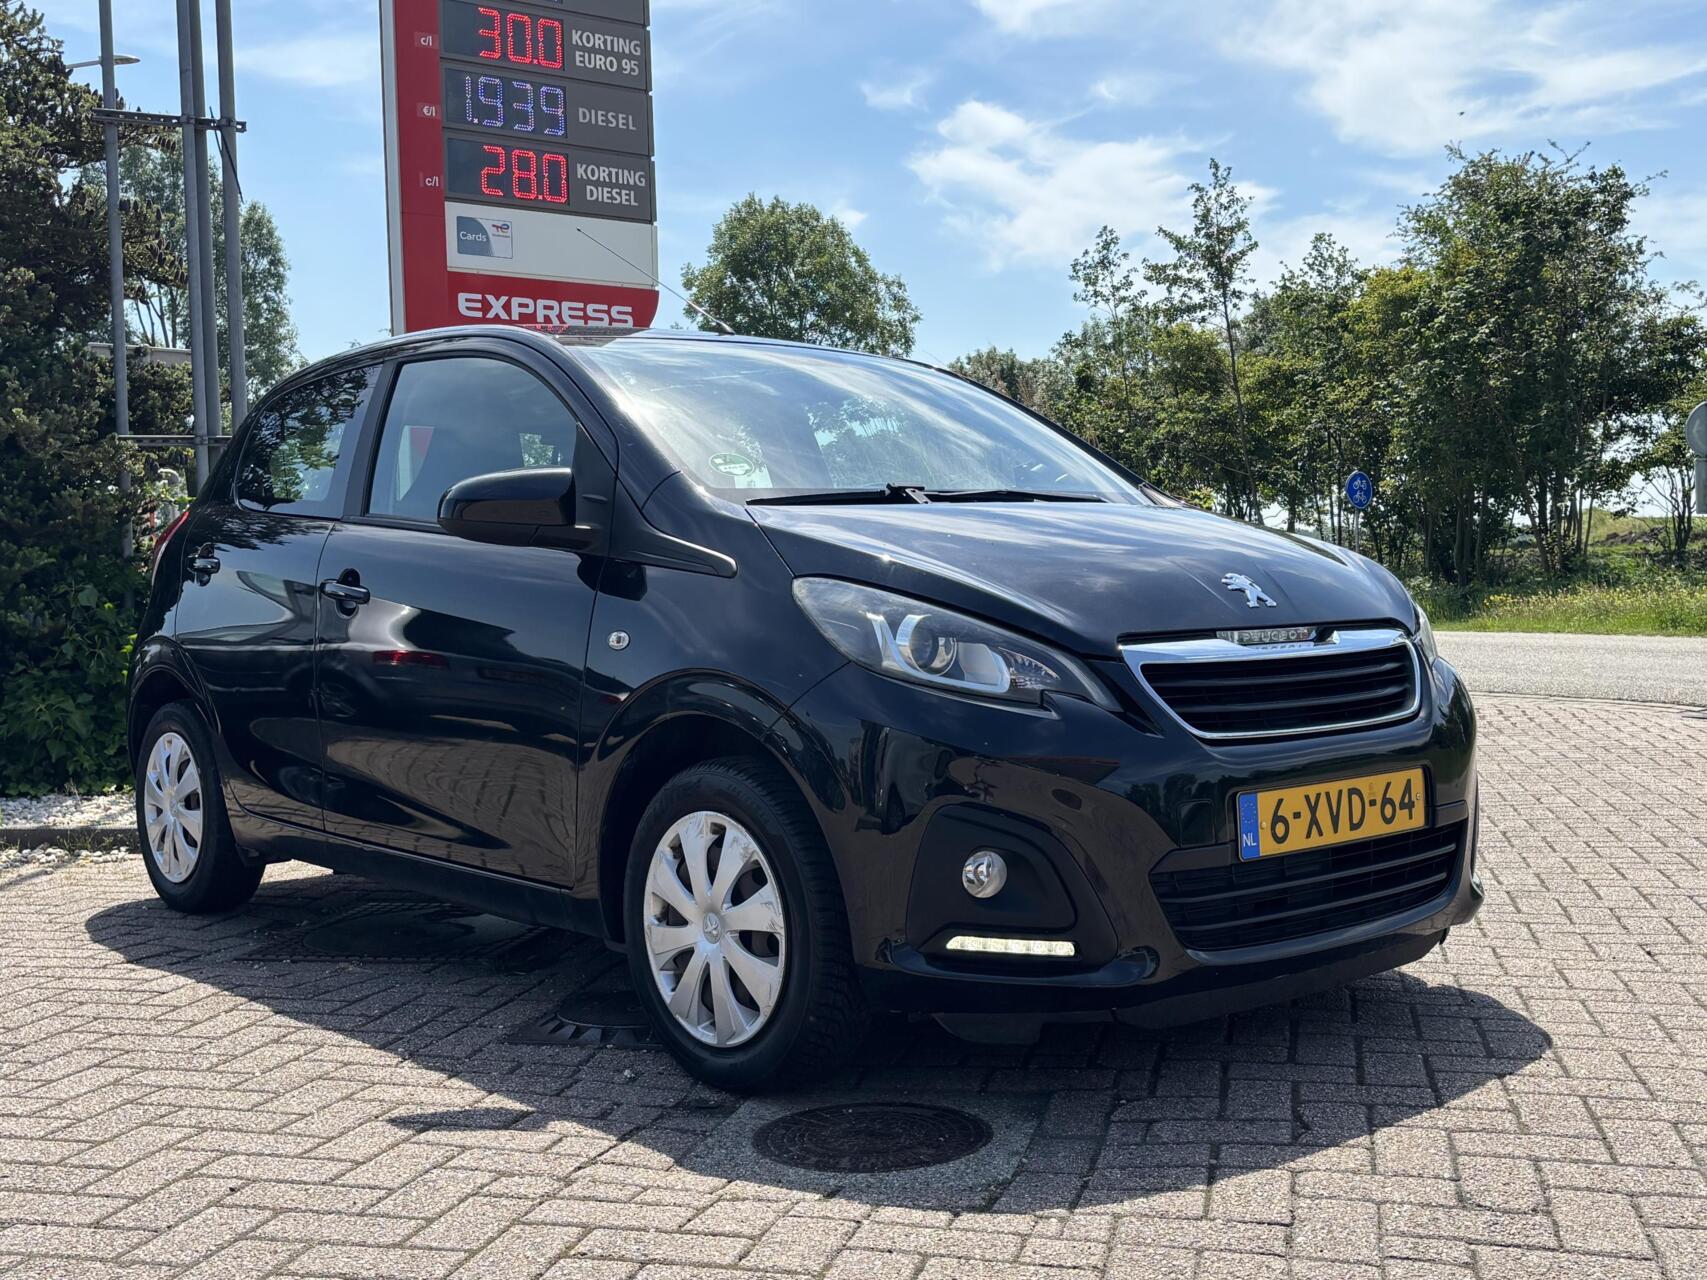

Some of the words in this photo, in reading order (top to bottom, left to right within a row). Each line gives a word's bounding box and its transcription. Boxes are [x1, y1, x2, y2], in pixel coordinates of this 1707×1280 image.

[478, 7, 564, 69] 30.0
[571, 29, 641, 56] KORTING
[575, 51, 618, 71] EURO
[622, 58, 640, 76] 95
[465, 75, 566, 136] 1.939
[578, 107, 637, 131] DIESEL
[481, 145, 568, 204] 28.0
[576, 163, 646, 187] KORTING
[586, 185, 639, 206] DIESEL
[460, 231, 487, 242] Cards
[457, 292, 634, 328] EXPRESS
[1242, 628, 1307, 642] PEUGEOT
[1270, 778, 1416, 845] 6-XVD-64
[1243, 833, 1257, 847] NL
